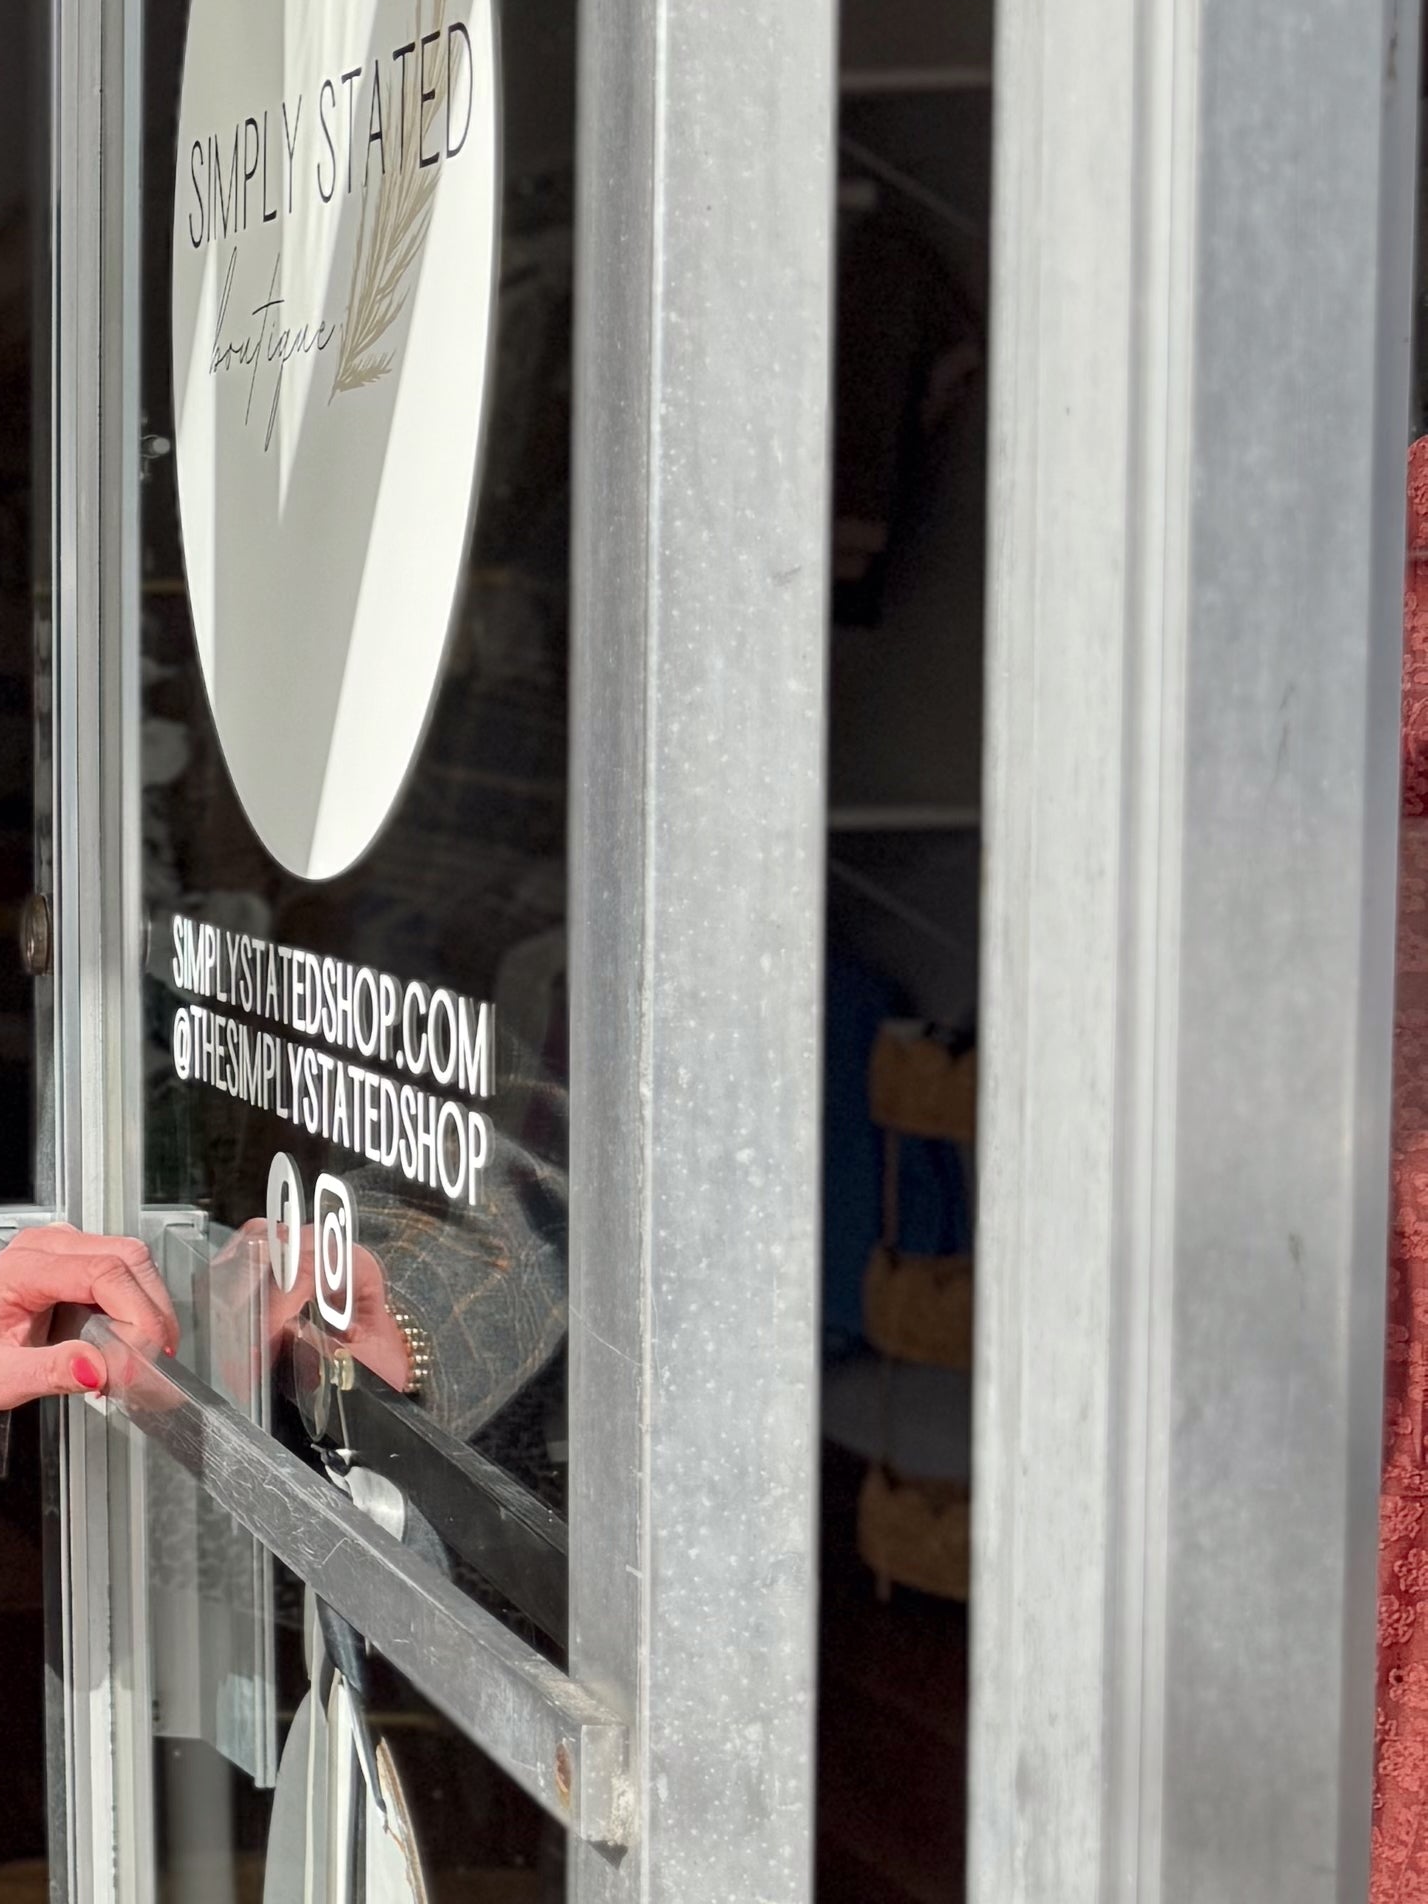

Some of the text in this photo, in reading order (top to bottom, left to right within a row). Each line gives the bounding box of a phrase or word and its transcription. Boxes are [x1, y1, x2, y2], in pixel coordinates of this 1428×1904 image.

[188, 21, 474, 249] SIMPLY STATED
[209, 246, 335, 452] boutique
[172, 914, 489, 1098] SIMPLYSTATEDSHOP.COM
[172, 1004, 488, 1206] @THESIMPLYSTATEDSHOP
